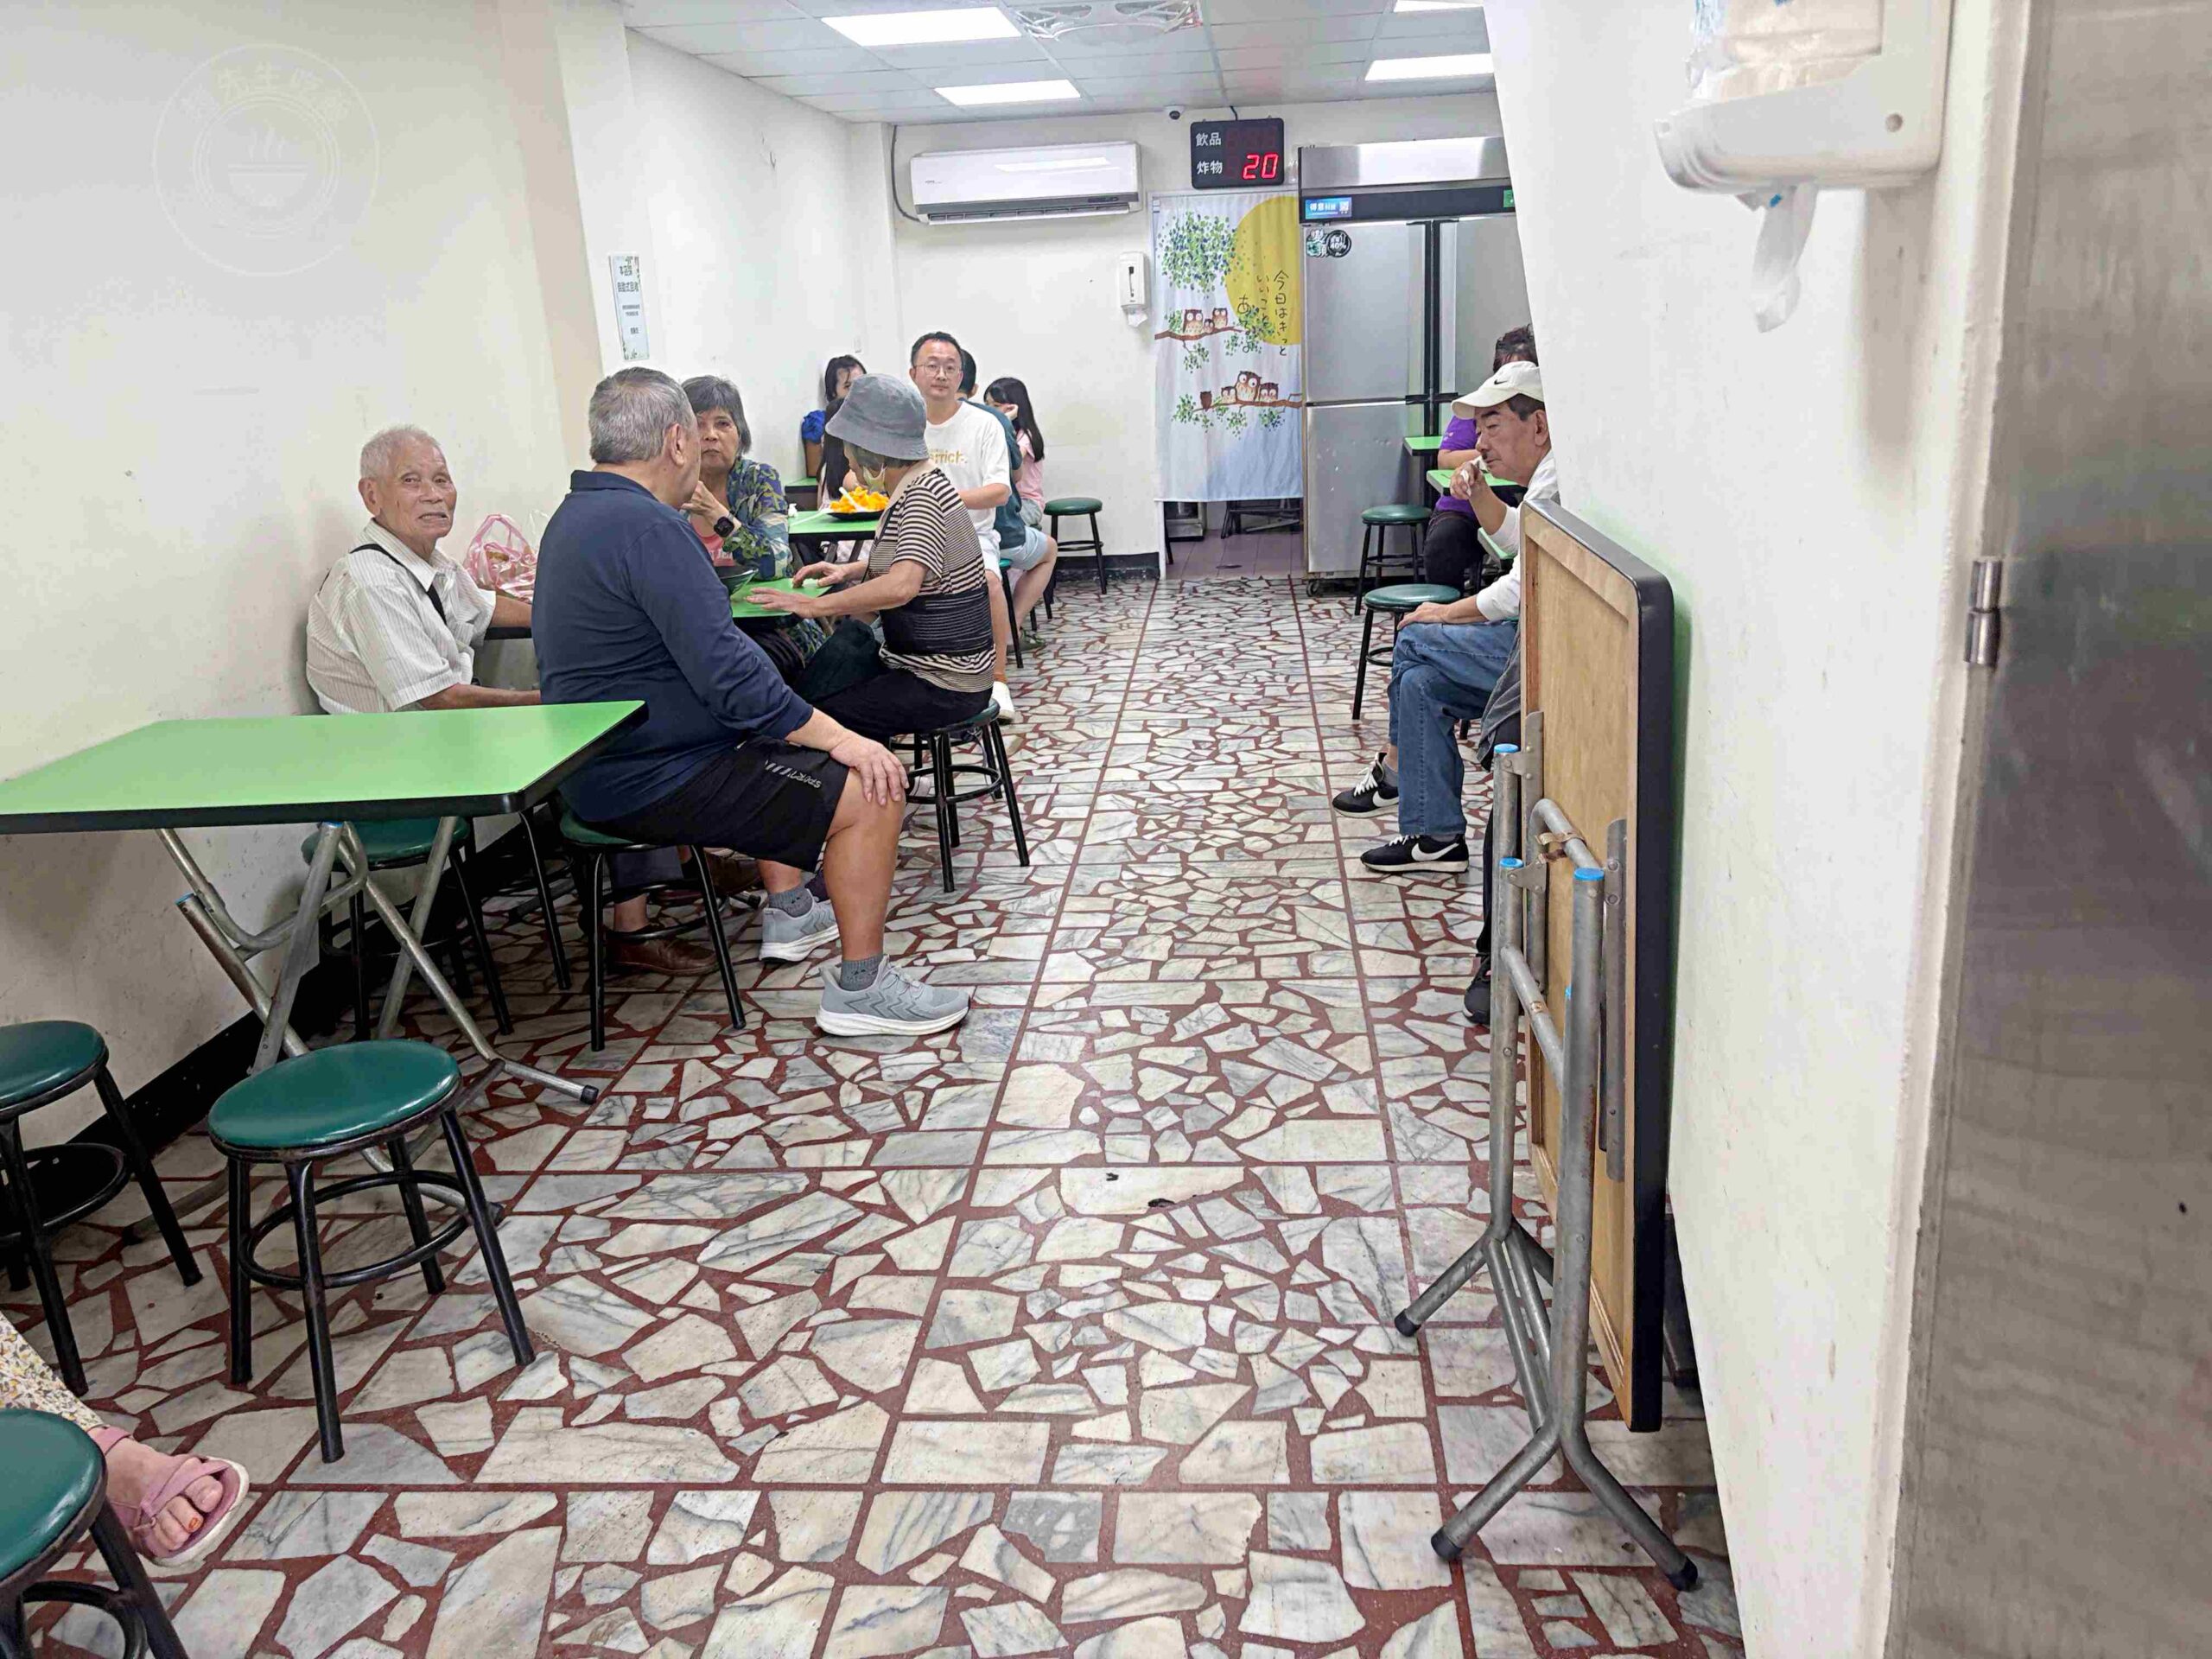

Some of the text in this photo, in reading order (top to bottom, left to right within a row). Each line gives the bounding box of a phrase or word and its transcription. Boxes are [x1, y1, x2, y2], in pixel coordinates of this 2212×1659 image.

[1195, 132, 1221, 147] 飲品
[1197, 154, 1278, 179] 炸物 20
[787, 771, 822, 788] SPORT
